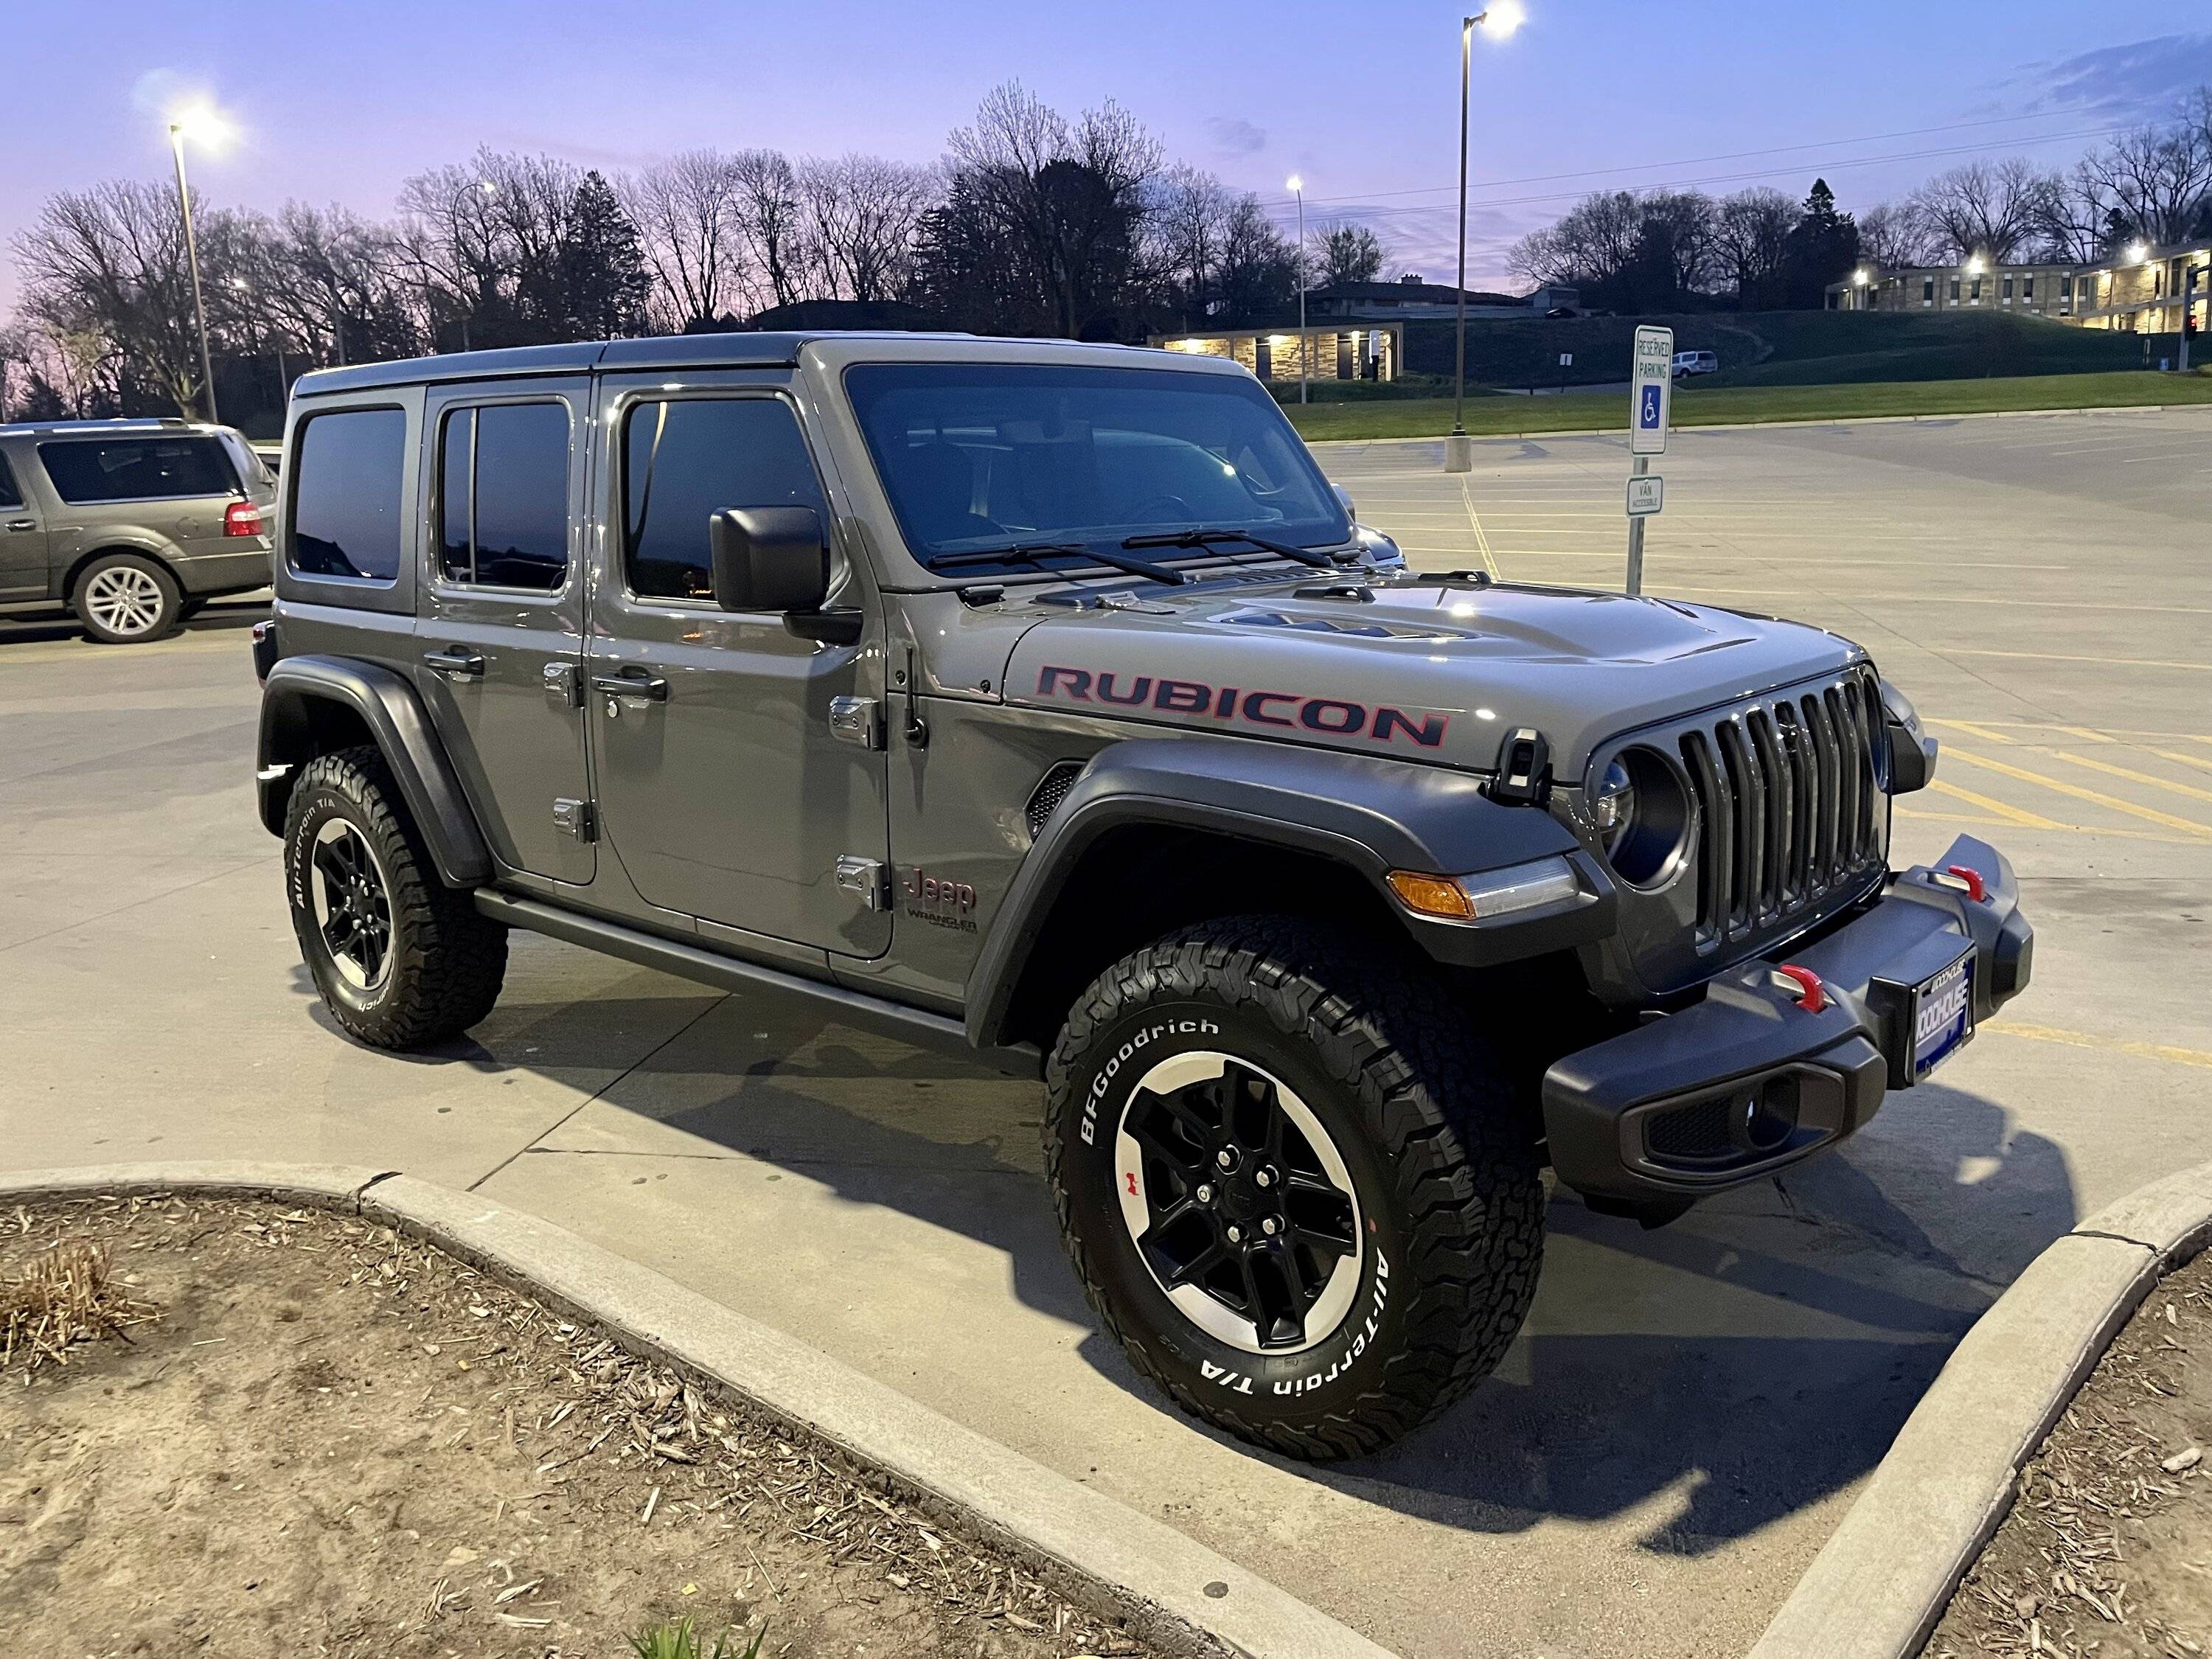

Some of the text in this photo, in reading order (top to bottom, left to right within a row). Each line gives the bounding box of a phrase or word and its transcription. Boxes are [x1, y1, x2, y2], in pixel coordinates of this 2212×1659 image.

[1638, 362, 1666, 378] PARKING
[1639, 340, 1669, 357] RESERVED
[1640, 484, 1652, 496] VAN
[1037, 665, 1450, 749] RUBICON
[293, 806, 316, 908] All-Terrain
[902, 867, 976, 914] Jeep
[907, 908, 978, 929] WRANGLER
[1080, 1018, 1219, 1146] BFGoodrich
[1200, 1246, 1389, 1397] All-Terrain T/A
